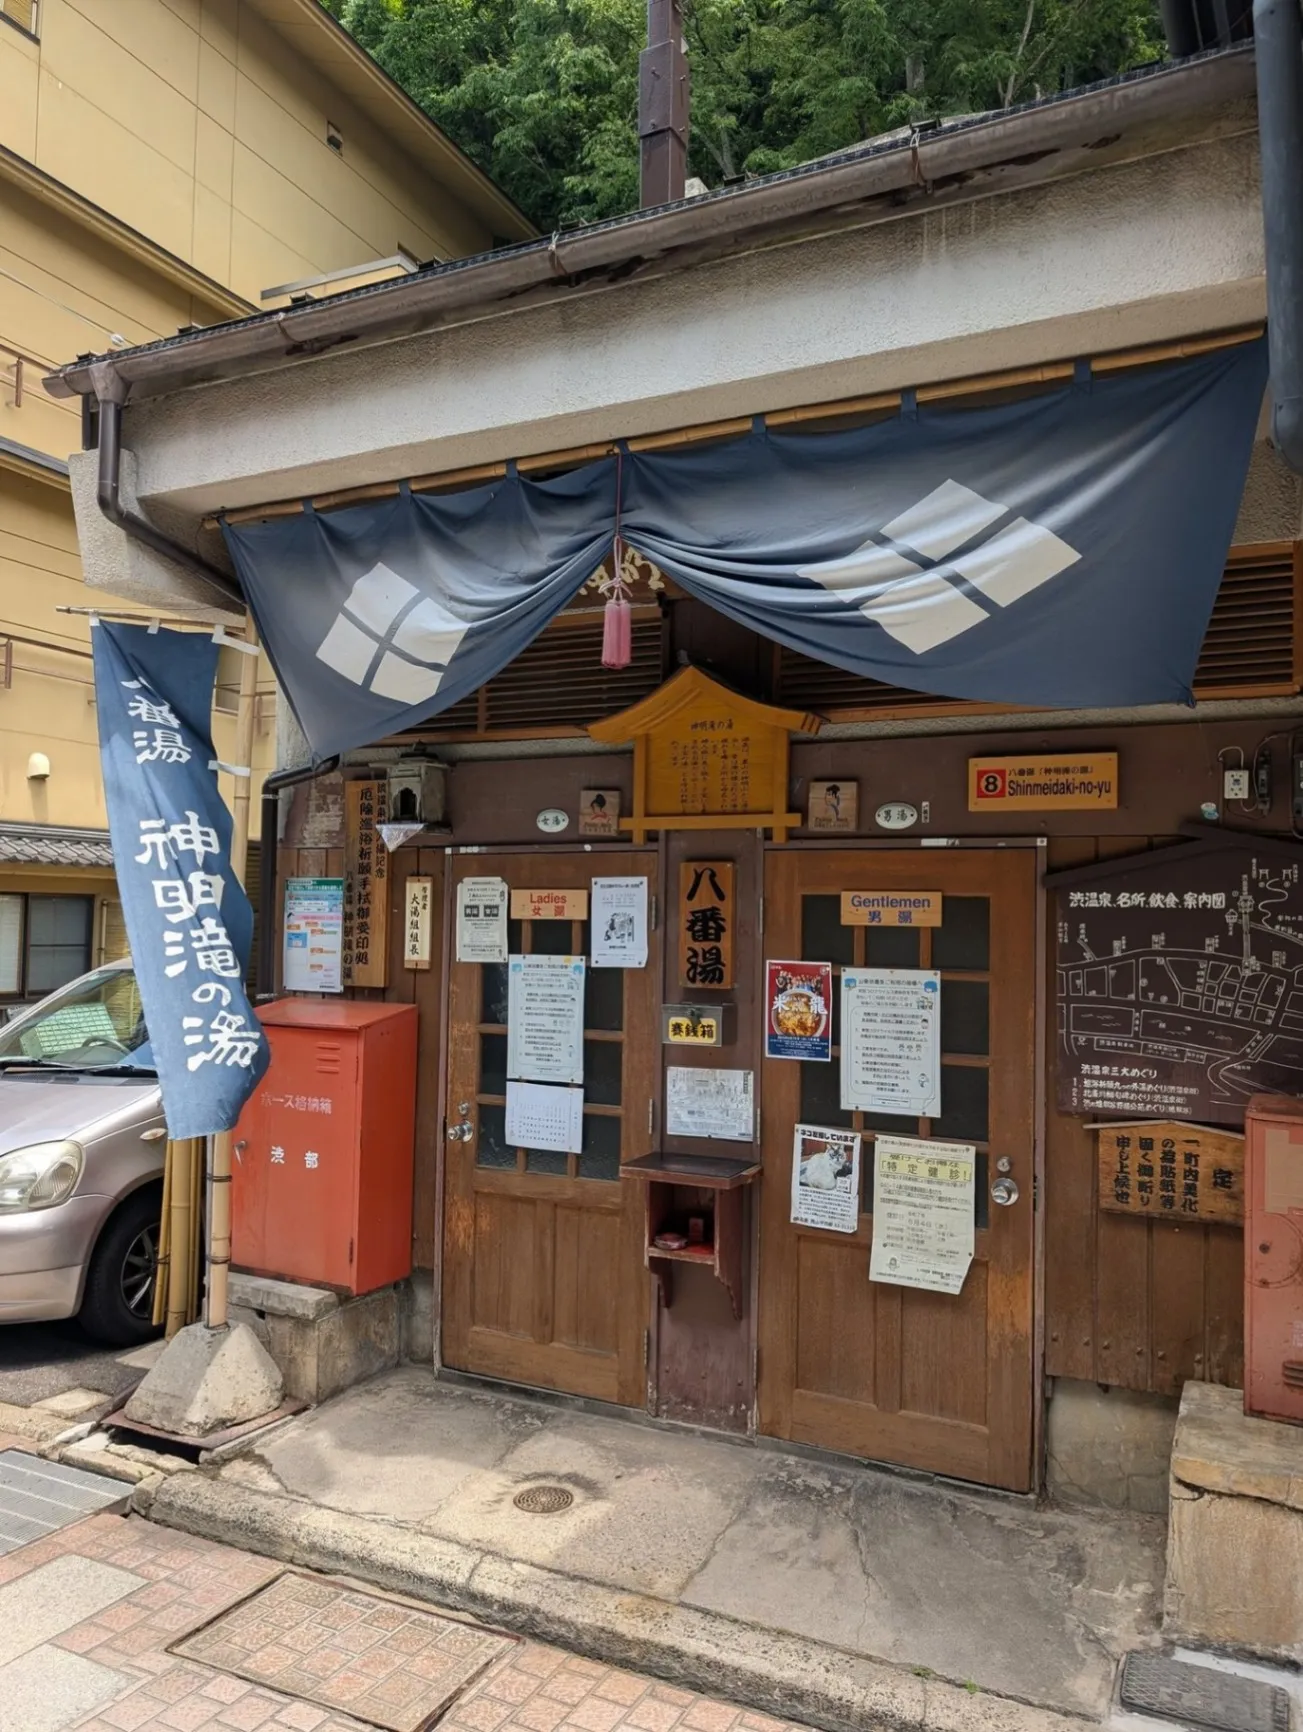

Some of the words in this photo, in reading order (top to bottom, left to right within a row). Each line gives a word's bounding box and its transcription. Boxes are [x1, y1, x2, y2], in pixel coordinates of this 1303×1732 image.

[984, 774, 998, 793] 8
[1008, 778, 1111, 798] Shinmeidaki-no-yu
[530, 893, 567, 904] Ladies
[851, 895, 930, 909] Gentlemen
[686, 867, 726, 984] 八番湯
[135, 810, 261, 1071] 神明滝の湯
[671, 1022, 714, 1039] 賽銭箱
[260, 1091, 332, 1115] ホース格納箱
[1213, 1168, 1234, 1190] 定
